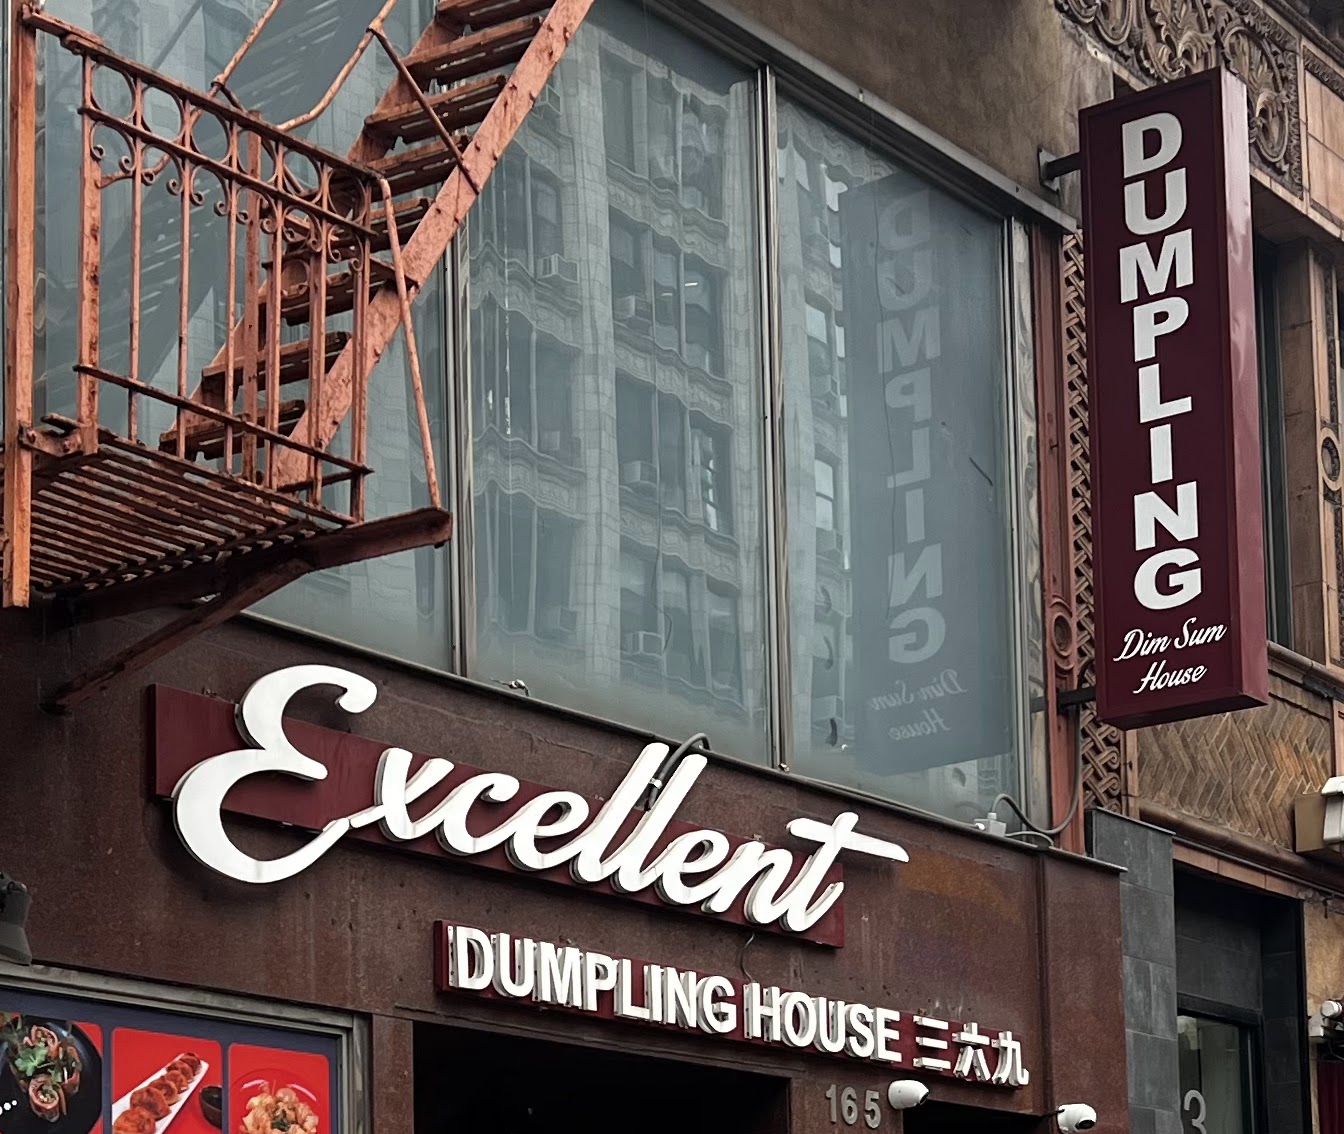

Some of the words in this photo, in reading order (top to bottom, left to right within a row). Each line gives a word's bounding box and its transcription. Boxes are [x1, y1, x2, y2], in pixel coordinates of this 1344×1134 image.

[1120, 112, 1202, 610] DUMPLING
[1113, 629, 1170, 662] Dim
[1175, 617, 1227, 647] Sum
[1133, 661, 1207, 694] House
[176, 664, 909, 932] Excellent
[447, 924, 738, 1034] DUMPLING
[745, 981, 902, 1065] HOUSE
[913, 1012, 1030, 1087] 三六九
[825, 1084, 882, 1129] 165
